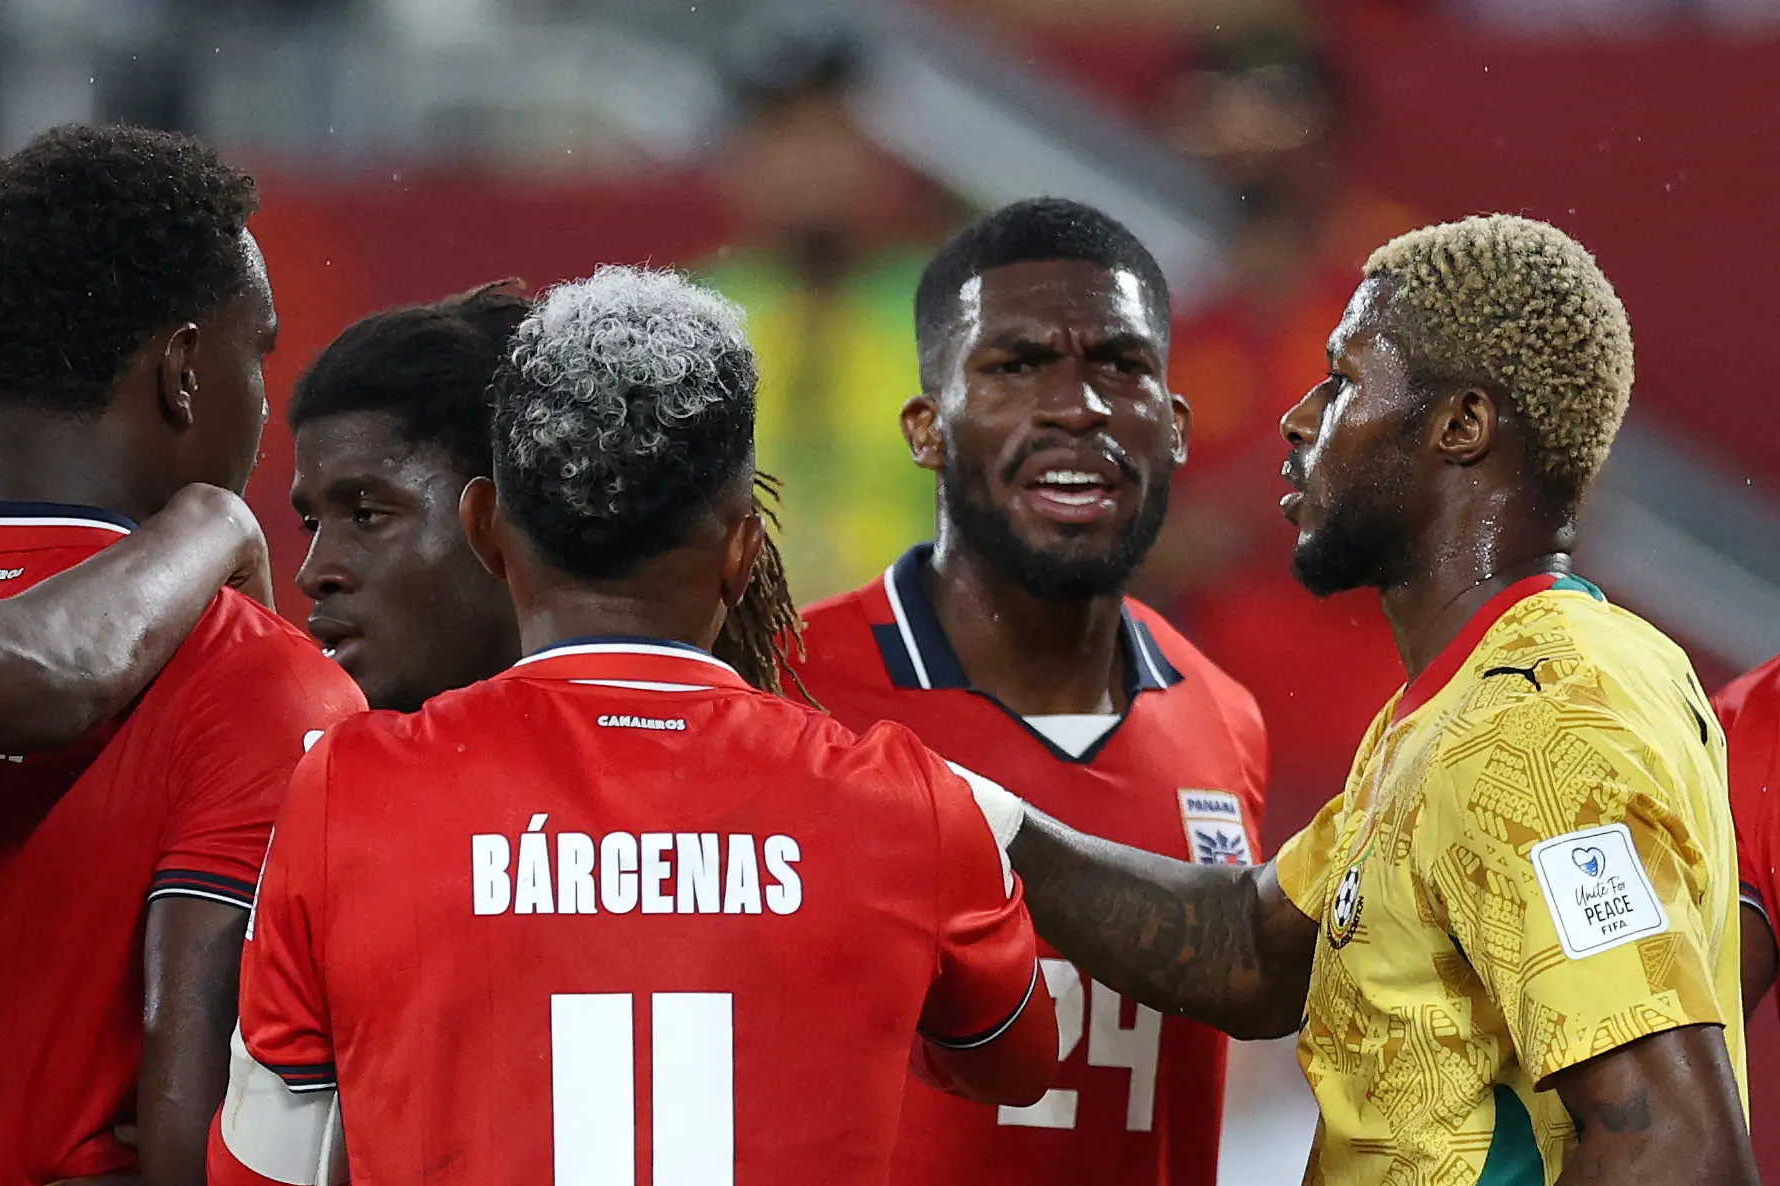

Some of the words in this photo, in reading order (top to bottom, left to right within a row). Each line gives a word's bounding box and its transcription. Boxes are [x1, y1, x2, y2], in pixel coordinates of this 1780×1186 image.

[596, 714, 687, 732] CANALEROS
[471, 812, 803, 916] BÁRCENAS
[1575, 880, 1609, 906] Unite
[1607, 875, 1626, 895] For
[1584, 894, 1634, 926] PEACE
[1601, 919, 1628, 935] FIFA
